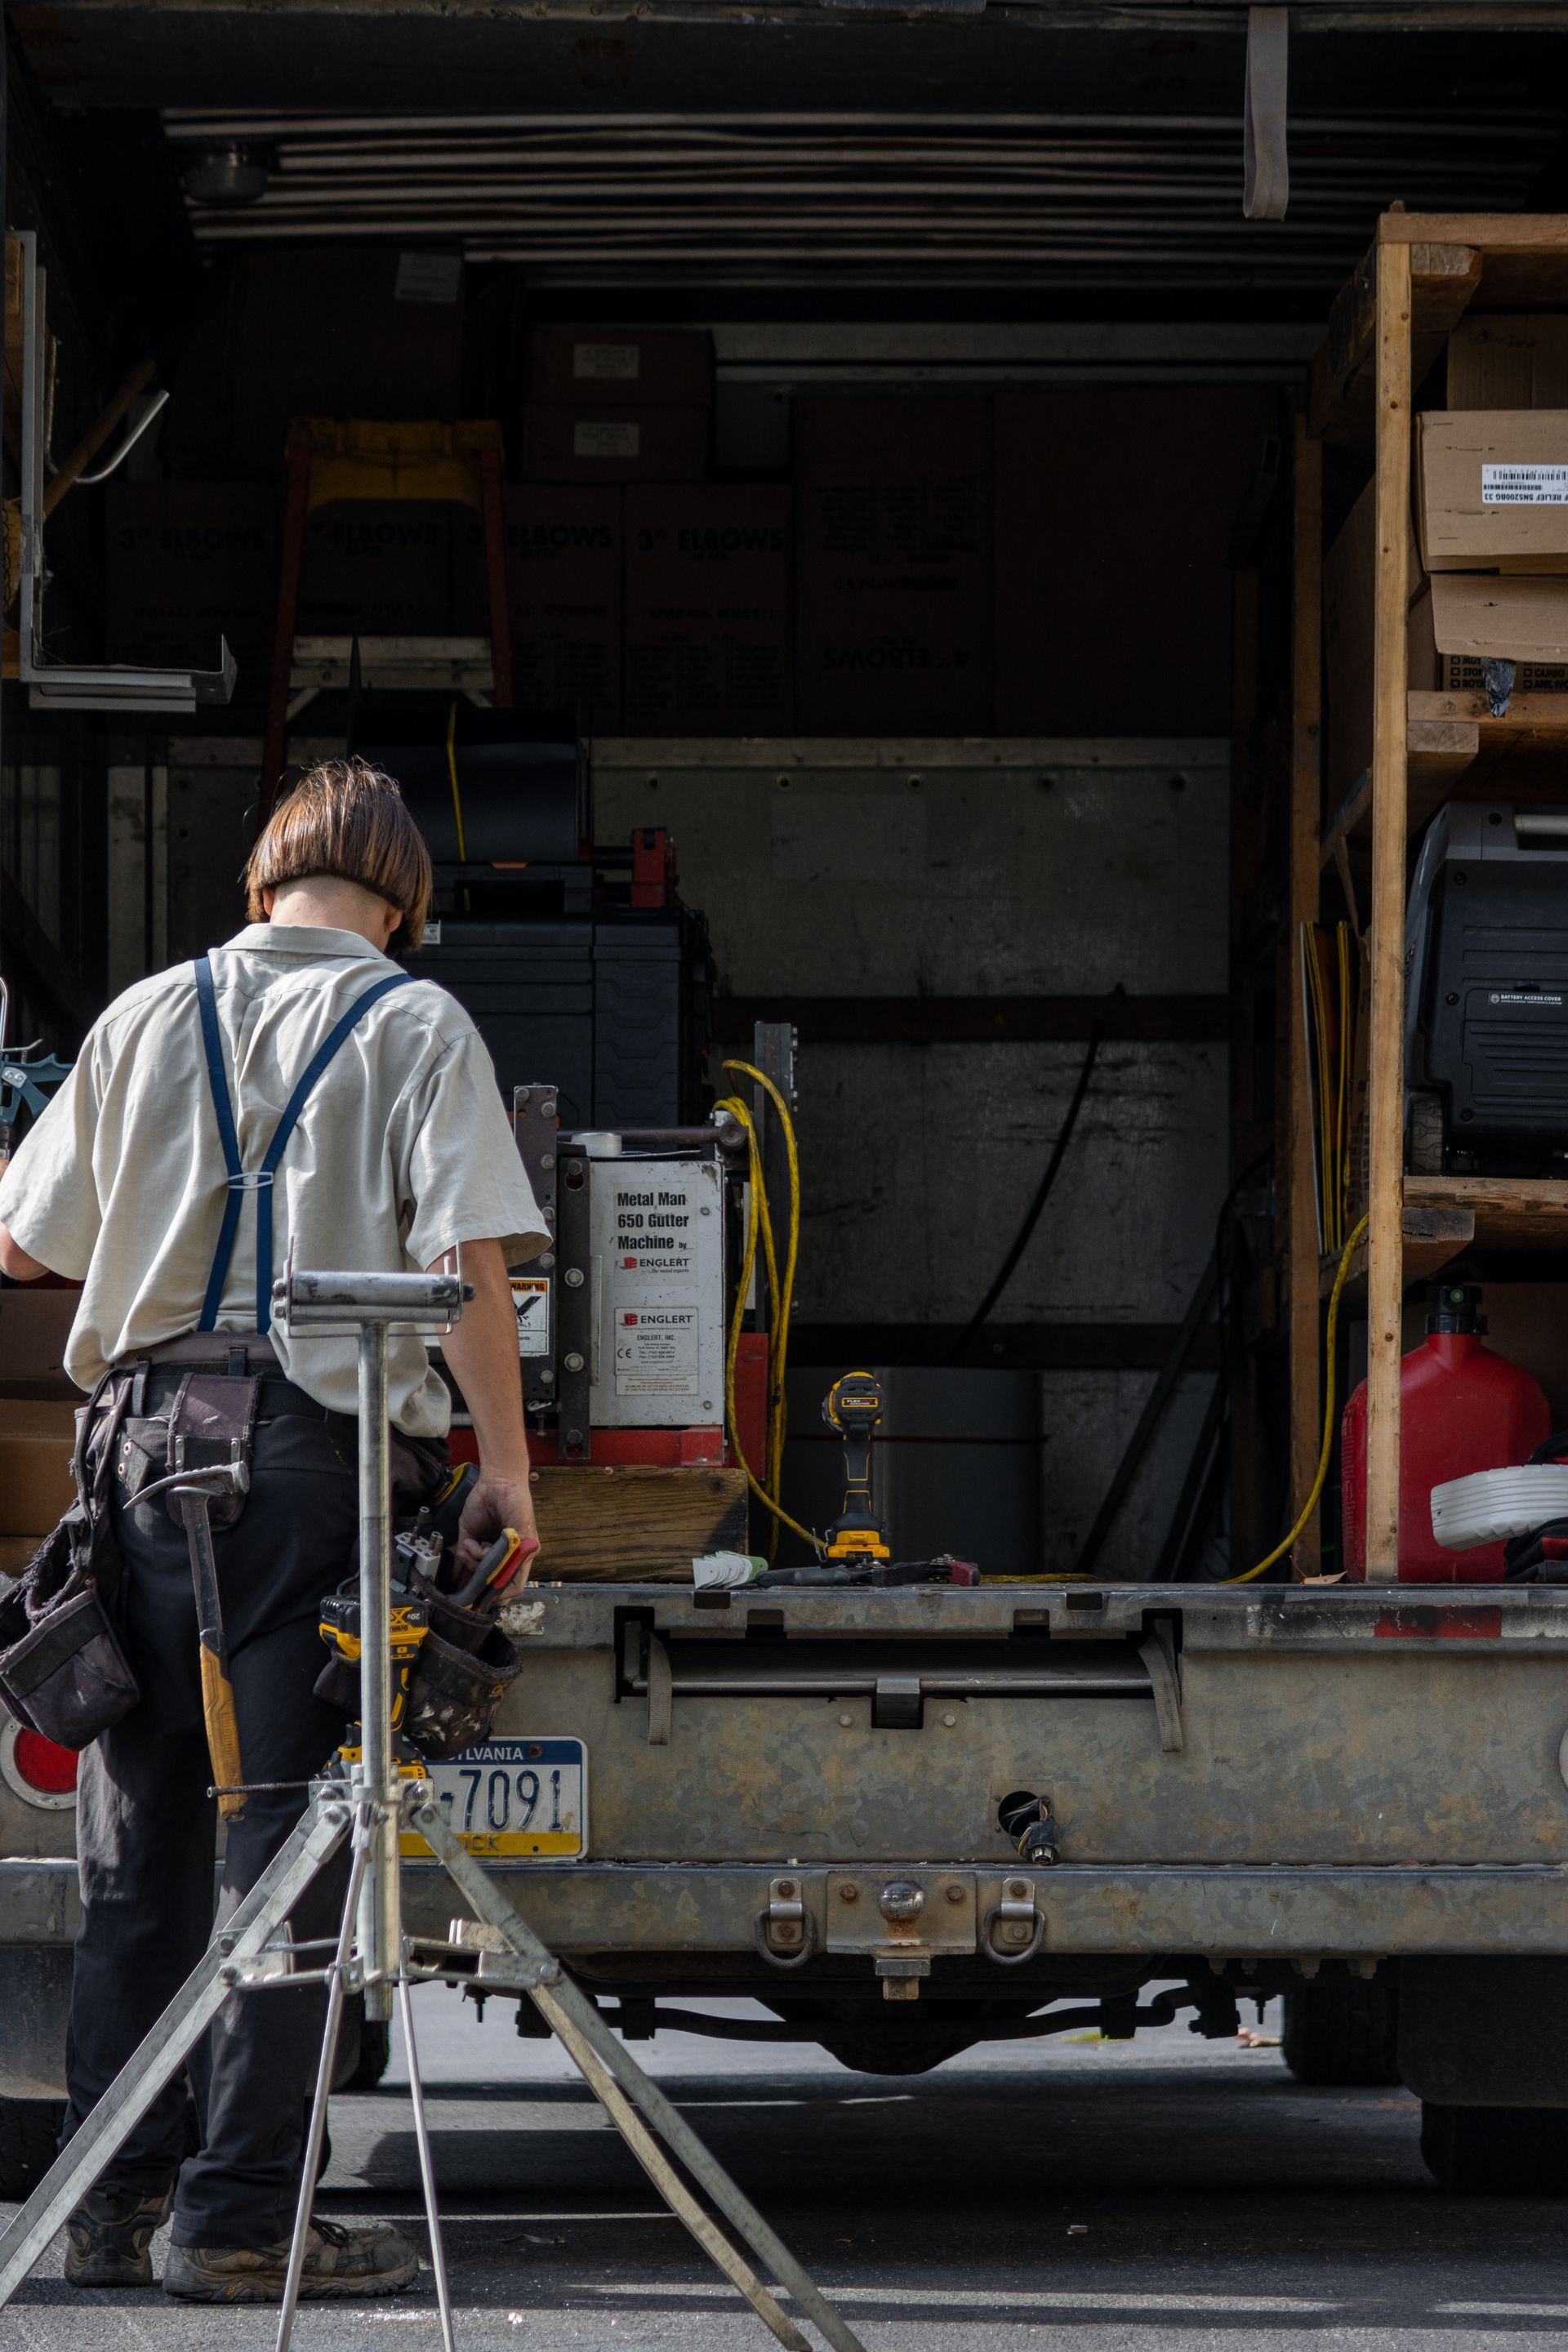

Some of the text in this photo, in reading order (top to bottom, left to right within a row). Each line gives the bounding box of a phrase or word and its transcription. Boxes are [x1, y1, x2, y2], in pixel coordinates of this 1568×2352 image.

[160, 528, 267, 550] ELBOWS
[333, 523, 439, 546] ELBOWS
[506, 525, 612, 547] ELBOWS
[678, 528, 784, 551] ELBOWS
[822, 647, 929, 670] ELBOWS
[1463, 657, 1481, 665] MUS
[1535, 669, 1565, 677] CAMEO
[1463, 679, 1486, 688] ROYA
[1555, 680, 1568, 688] IVO
[617, 1192, 686, 1206] Metal Man
[618, 1214, 689, 1227] 650 Gutter
[618, 1236, 674, 1250] Machine
[639, 1258, 689, 1267] ENGLERT
[640, 1315, 692, 1324] ENGLERT
[448, 1746, 523, 1761] LVANIA
[440, 1769, 564, 1831] -7091
